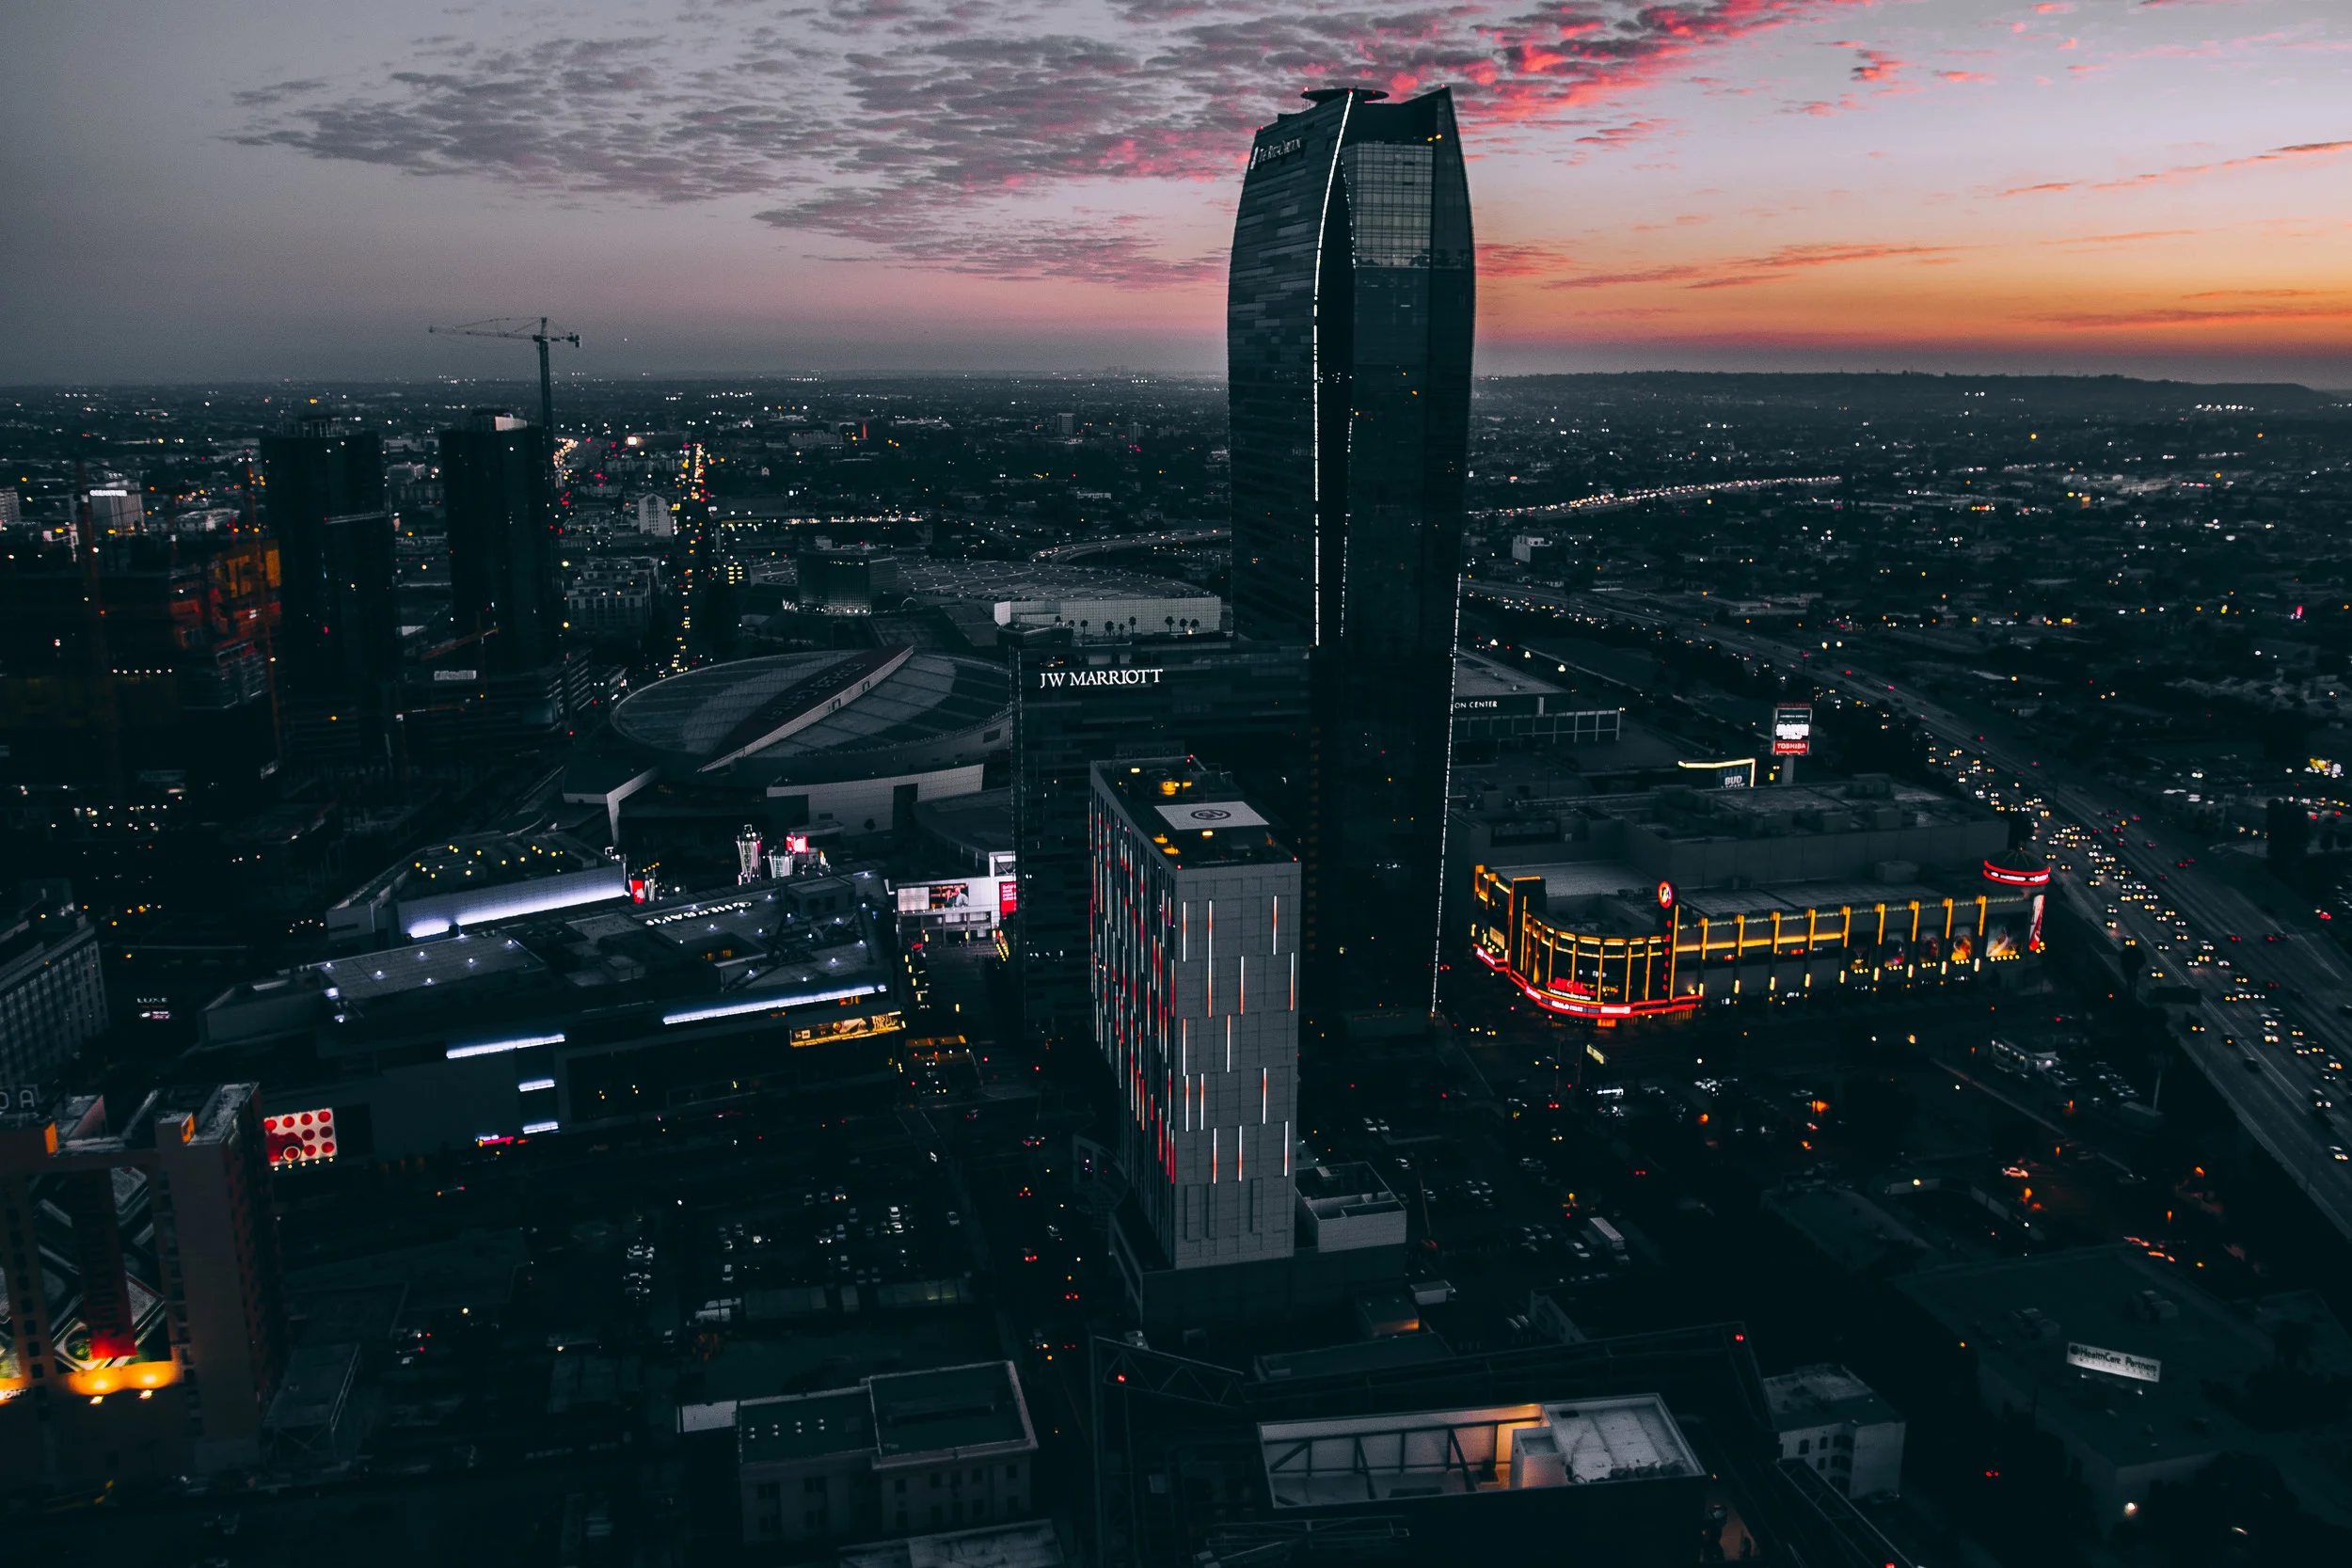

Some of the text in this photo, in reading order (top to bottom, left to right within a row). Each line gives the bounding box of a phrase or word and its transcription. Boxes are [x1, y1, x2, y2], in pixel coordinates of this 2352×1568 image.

[1040, 669, 1164, 689] JW MARRIOTT
[1469, 700, 1498, 708] CENTER
[1724, 775, 1742, 785] BUD
[2080, 1346, 2122, 1365] HealthCare
[2125, 1355, 2157, 1372] Partners
